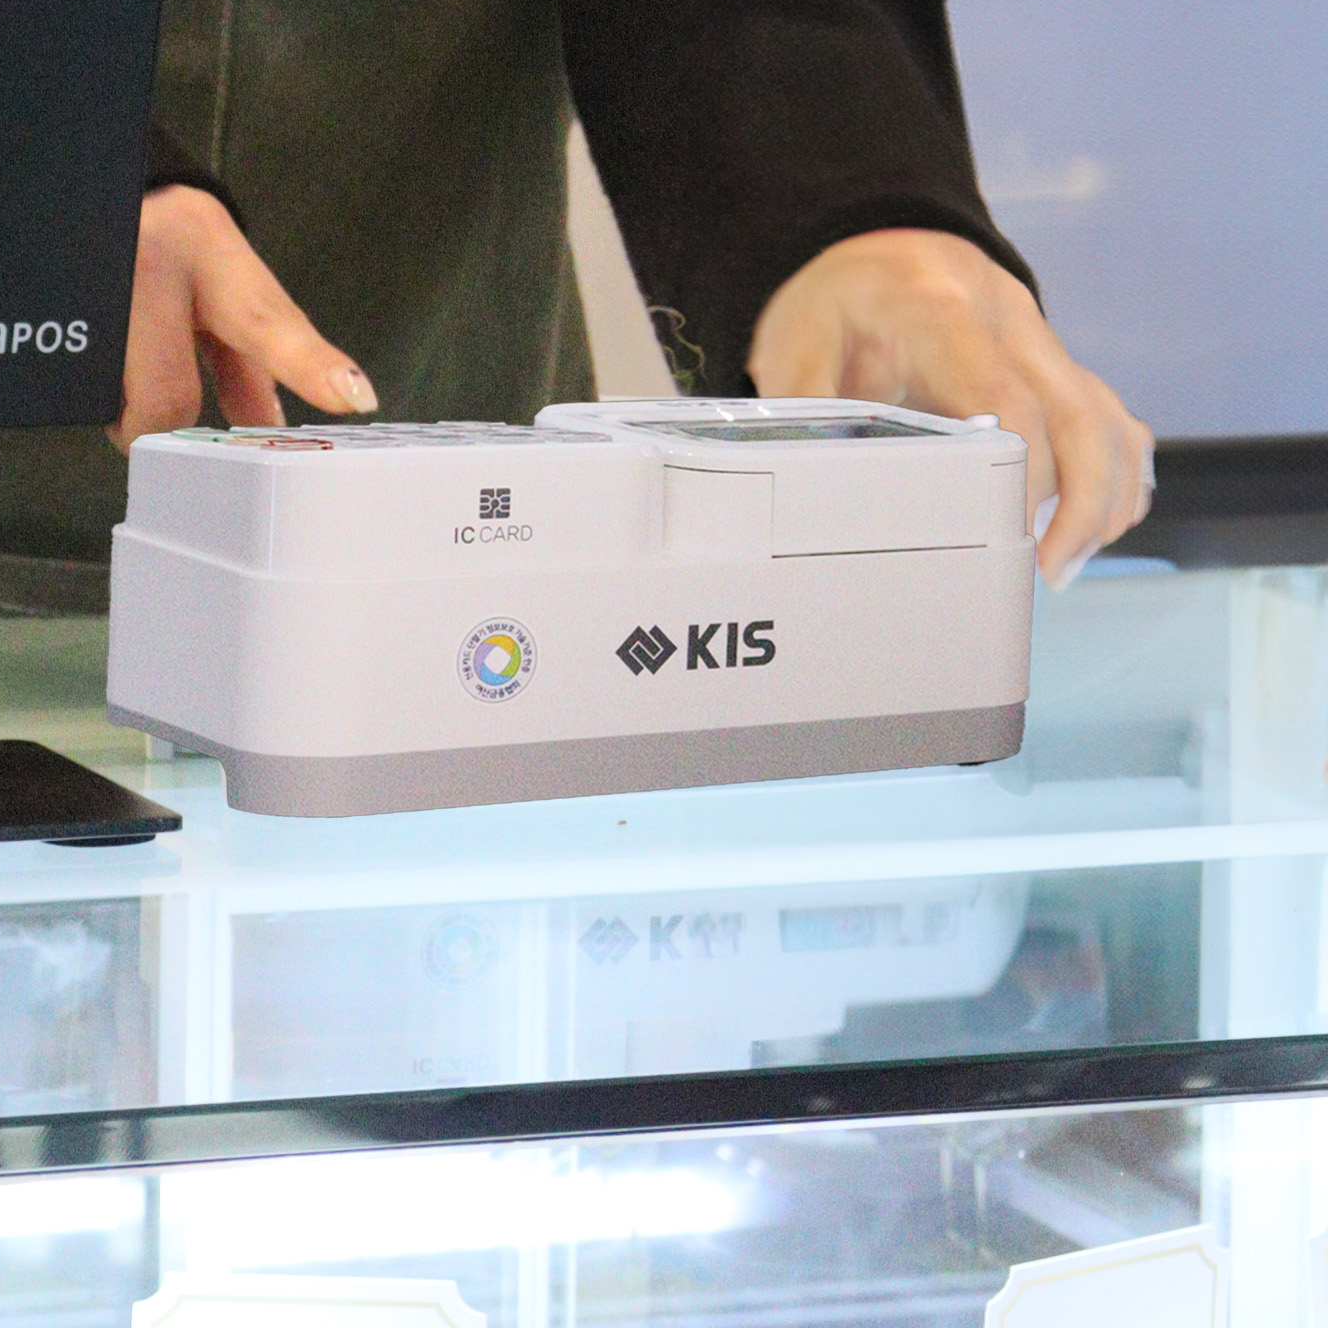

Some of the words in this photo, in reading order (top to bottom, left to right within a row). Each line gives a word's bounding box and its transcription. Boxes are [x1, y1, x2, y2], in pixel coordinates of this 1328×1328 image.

[454, 527, 476, 544] IC
[479, 525, 533, 543] CARD
[686, 620, 776, 671] KIS
